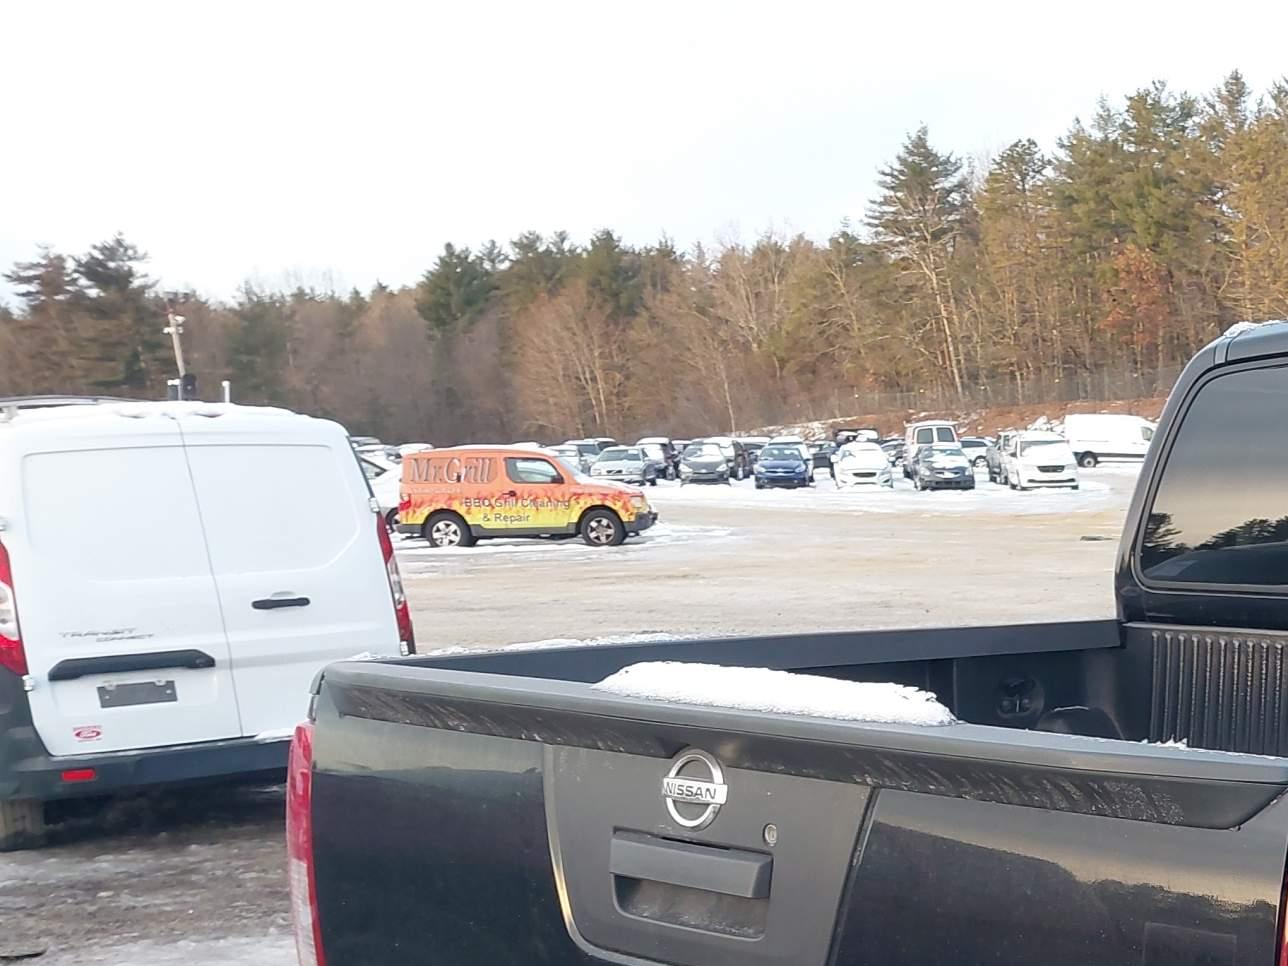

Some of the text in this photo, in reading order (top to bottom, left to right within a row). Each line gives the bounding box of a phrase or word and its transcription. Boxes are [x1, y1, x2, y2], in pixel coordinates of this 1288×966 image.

[464, 497, 492, 508] BBQ
[521, 498, 569, 510] Cleaning
[482, 512, 530, 524] & Repair
[664, 781, 717, 800] NISSAN
